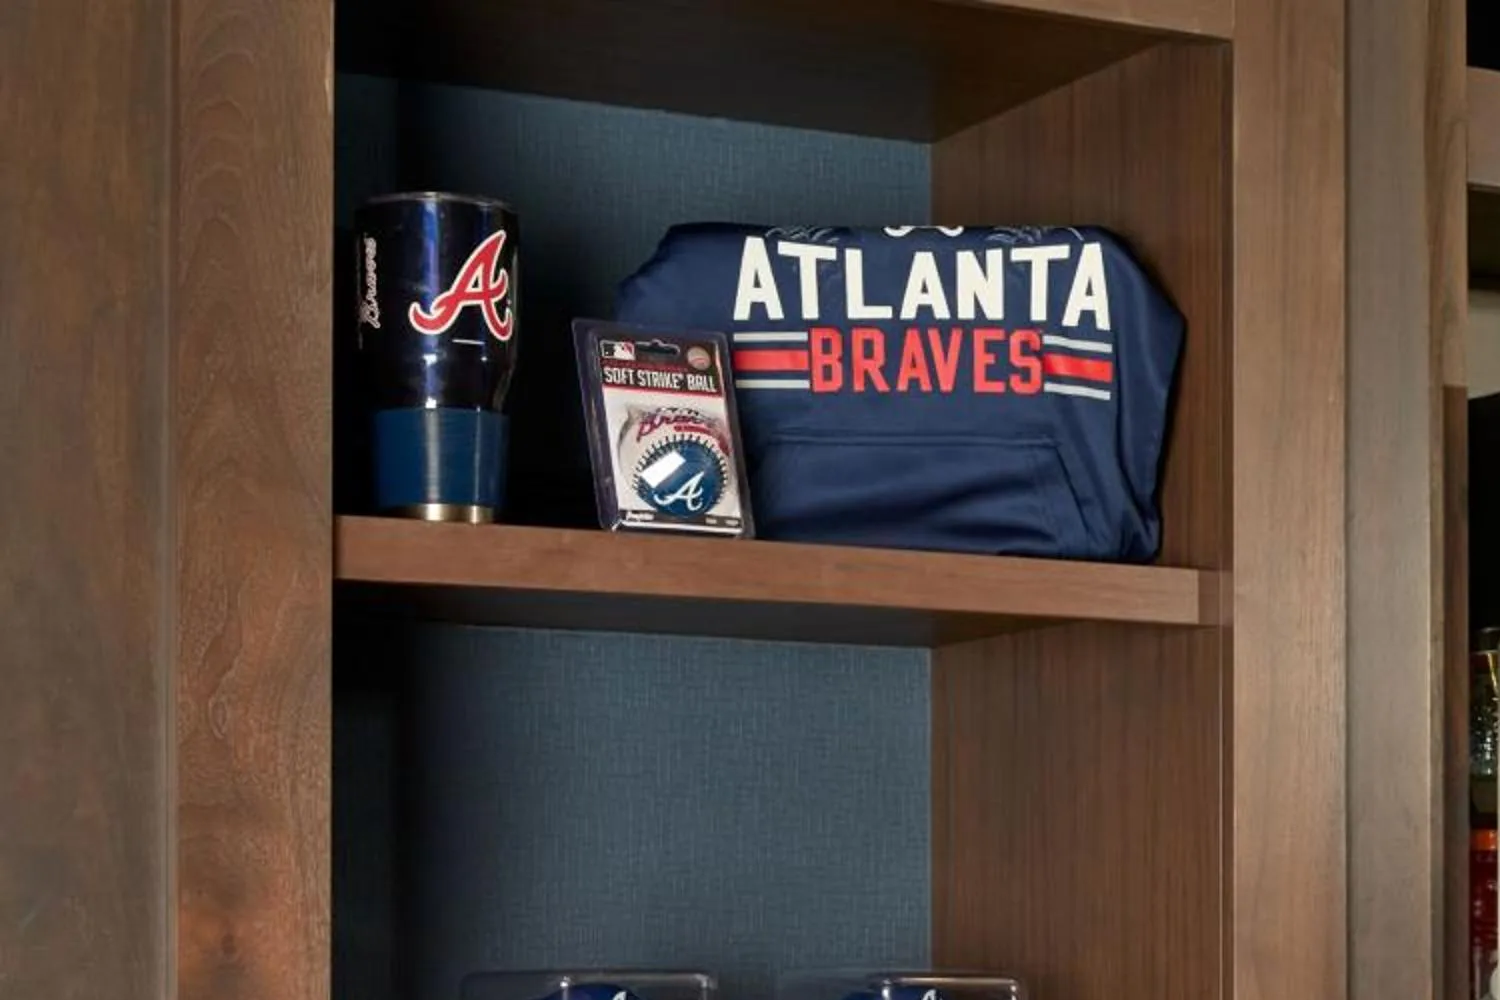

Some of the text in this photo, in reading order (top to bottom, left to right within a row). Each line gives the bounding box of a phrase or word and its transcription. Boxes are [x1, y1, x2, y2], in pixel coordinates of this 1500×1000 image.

[732, 235, 1111, 331] ATLANTA
[603, 366, 716, 393] SOFT STRIKE BALL
[808, 326, 1044, 394] BRAVES
